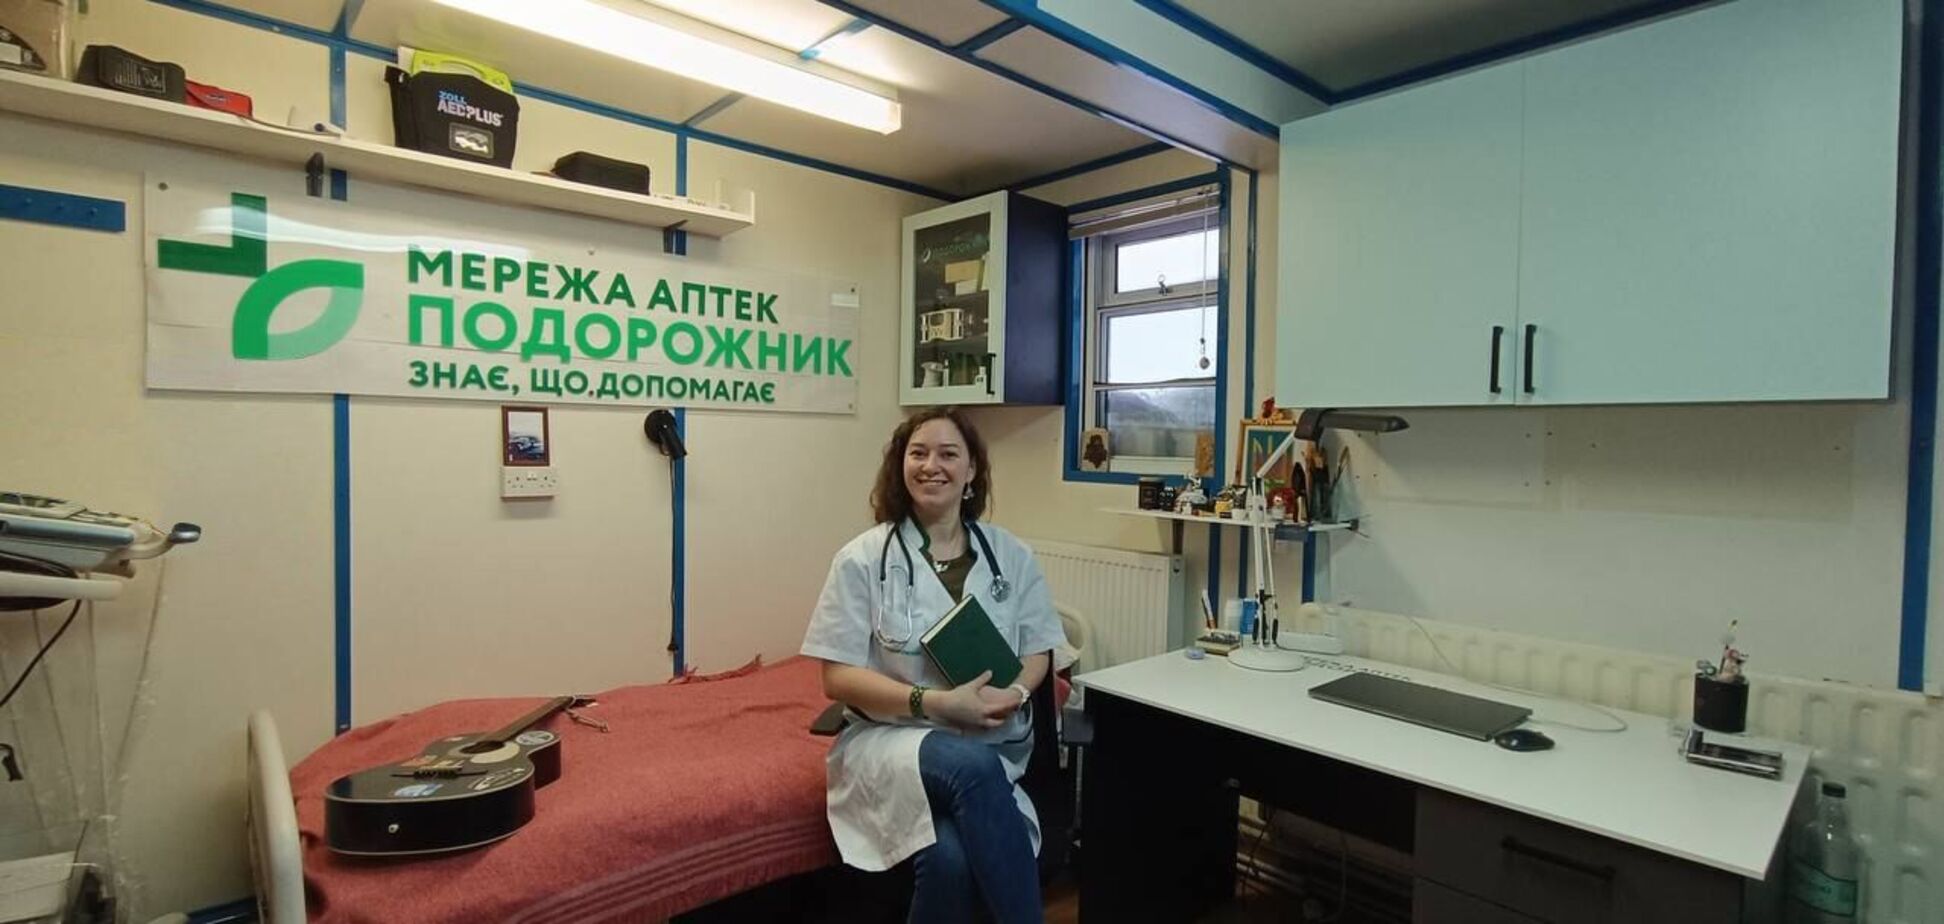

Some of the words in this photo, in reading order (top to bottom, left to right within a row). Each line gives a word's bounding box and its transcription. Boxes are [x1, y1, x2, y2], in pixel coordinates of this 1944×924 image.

[438, 90, 467, 106] ZOLL
[408, 246, 636, 308] МЕРЕЖА
[647, 279, 779, 324] АПТЕК
[408, 294, 853, 377] ПОДОРОЖНИК
[408, 360, 520, 396] ЗНАЄ,
[531, 368, 589, 397] ЩО
[596, 372, 776, 403] ДОПОМАГАЄ
